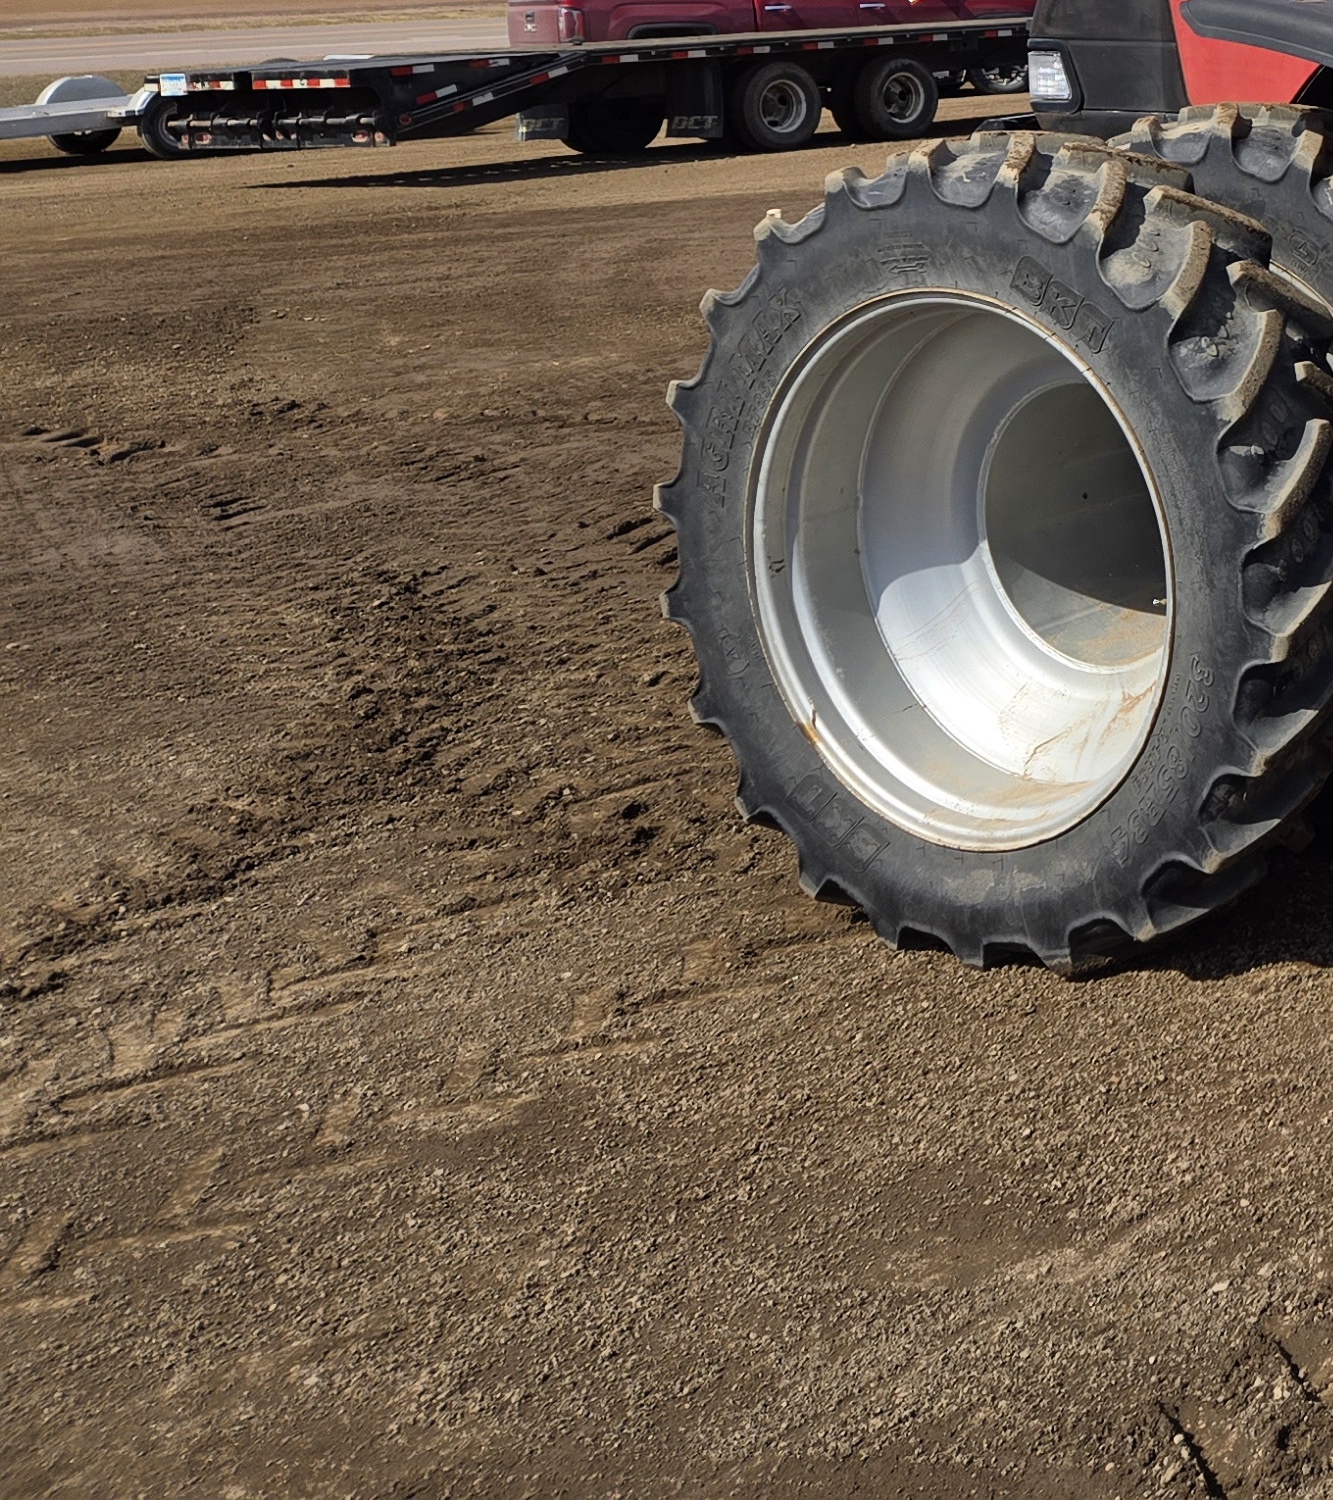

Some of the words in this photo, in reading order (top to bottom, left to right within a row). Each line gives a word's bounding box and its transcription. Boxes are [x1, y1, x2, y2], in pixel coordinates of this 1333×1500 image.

[1011, 260, 1112, 352] BKT
[697, 286, 802, 509] AGRIMAX
[788, 778, 885, 868] BKT
[1109, 651, 1214, 869] 320/85R34
